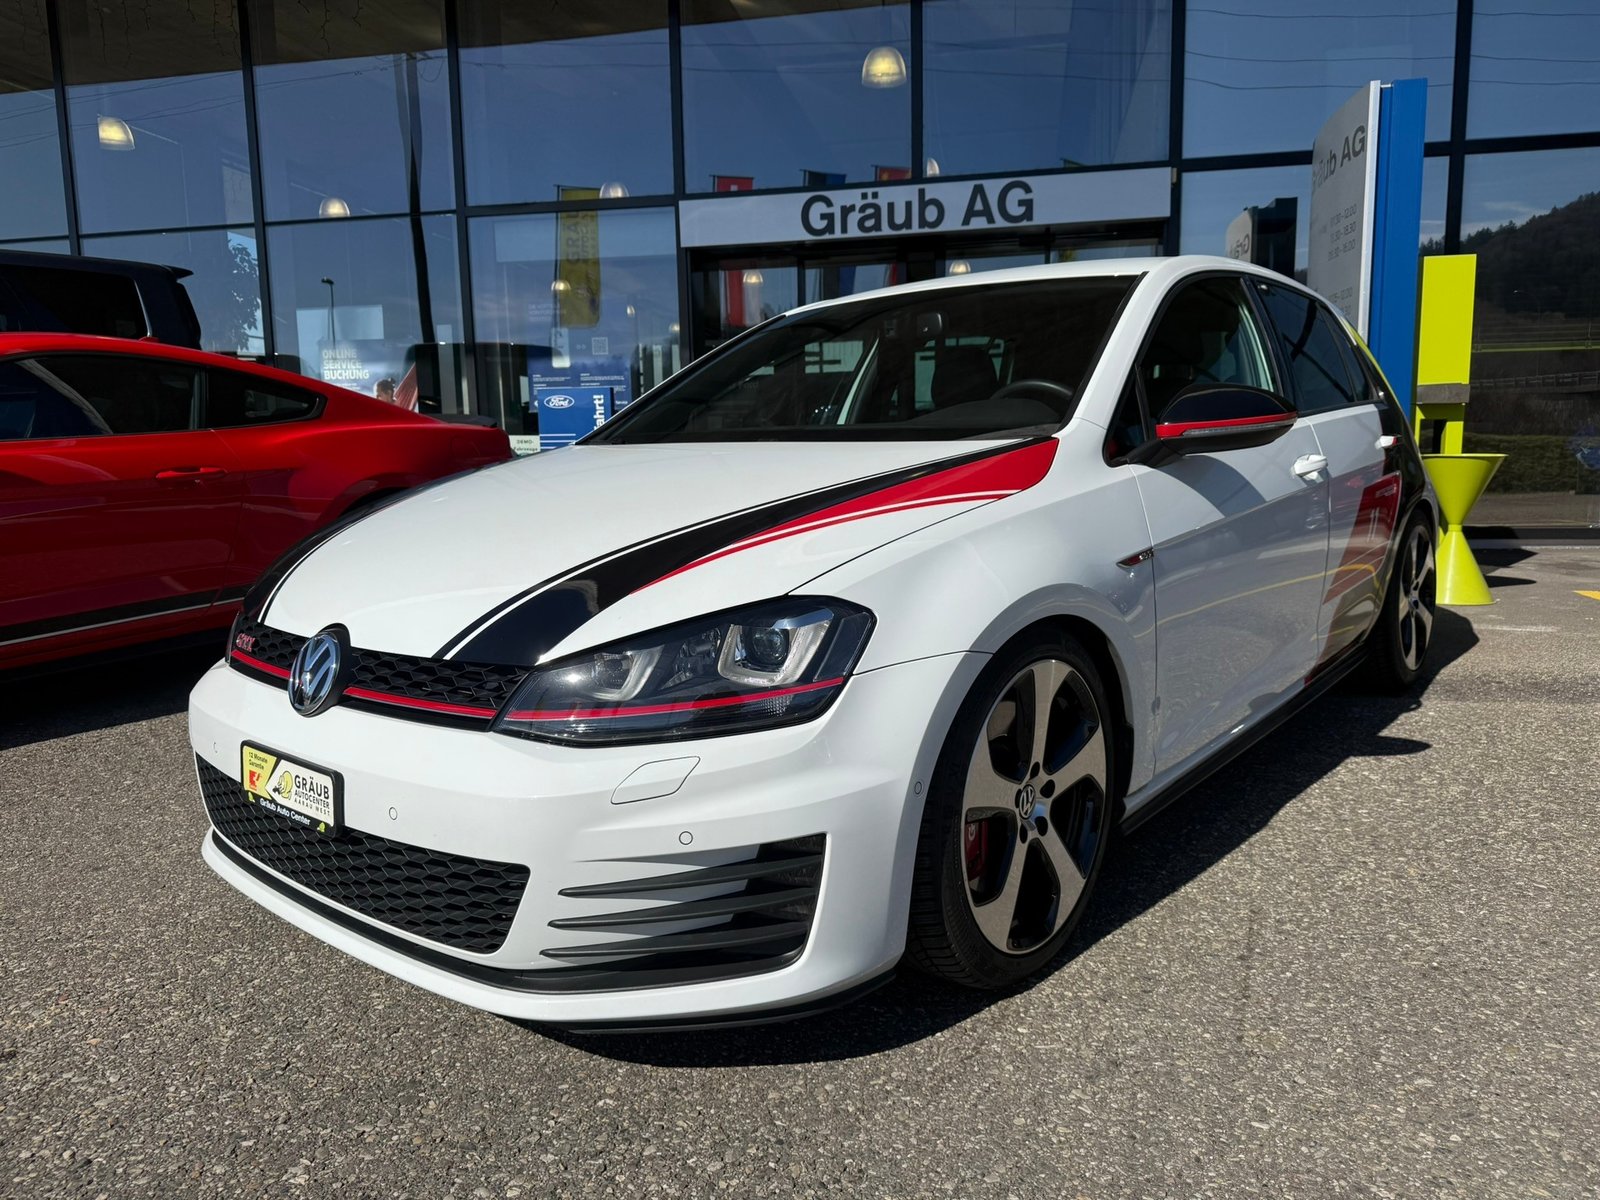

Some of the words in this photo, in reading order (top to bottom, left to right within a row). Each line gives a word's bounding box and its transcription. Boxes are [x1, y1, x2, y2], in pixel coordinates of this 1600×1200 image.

[1313, 149, 1337, 188] räub
[1340, 125, 1366, 169] AG
[801, 188, 945, 237] Gräub
[961, 180, 1034, 226] AG
[322, 349, 357, 359] ONLINE
[323, 360, 362, 369] SERVICE
[323, 369, 370, 380] BUCHUNG
[547, 396, 571, 407] Ford
[593, 394, 604, 430] ahrt!
[248, 759, 265, 770] Garantie
[254, 753, 268, 764] Monate
[294, 774, 330, 800] GRÄUB
[294, 789, 330, 810] AUTOCENTER
[294, 798, 313, 810] AARAU
[316, 805, 330, 816] WEST
[260, 798, 277, 811] Gräub
[277, 805, 290, 818] Auto
[290, 811, 311, 826] Center
